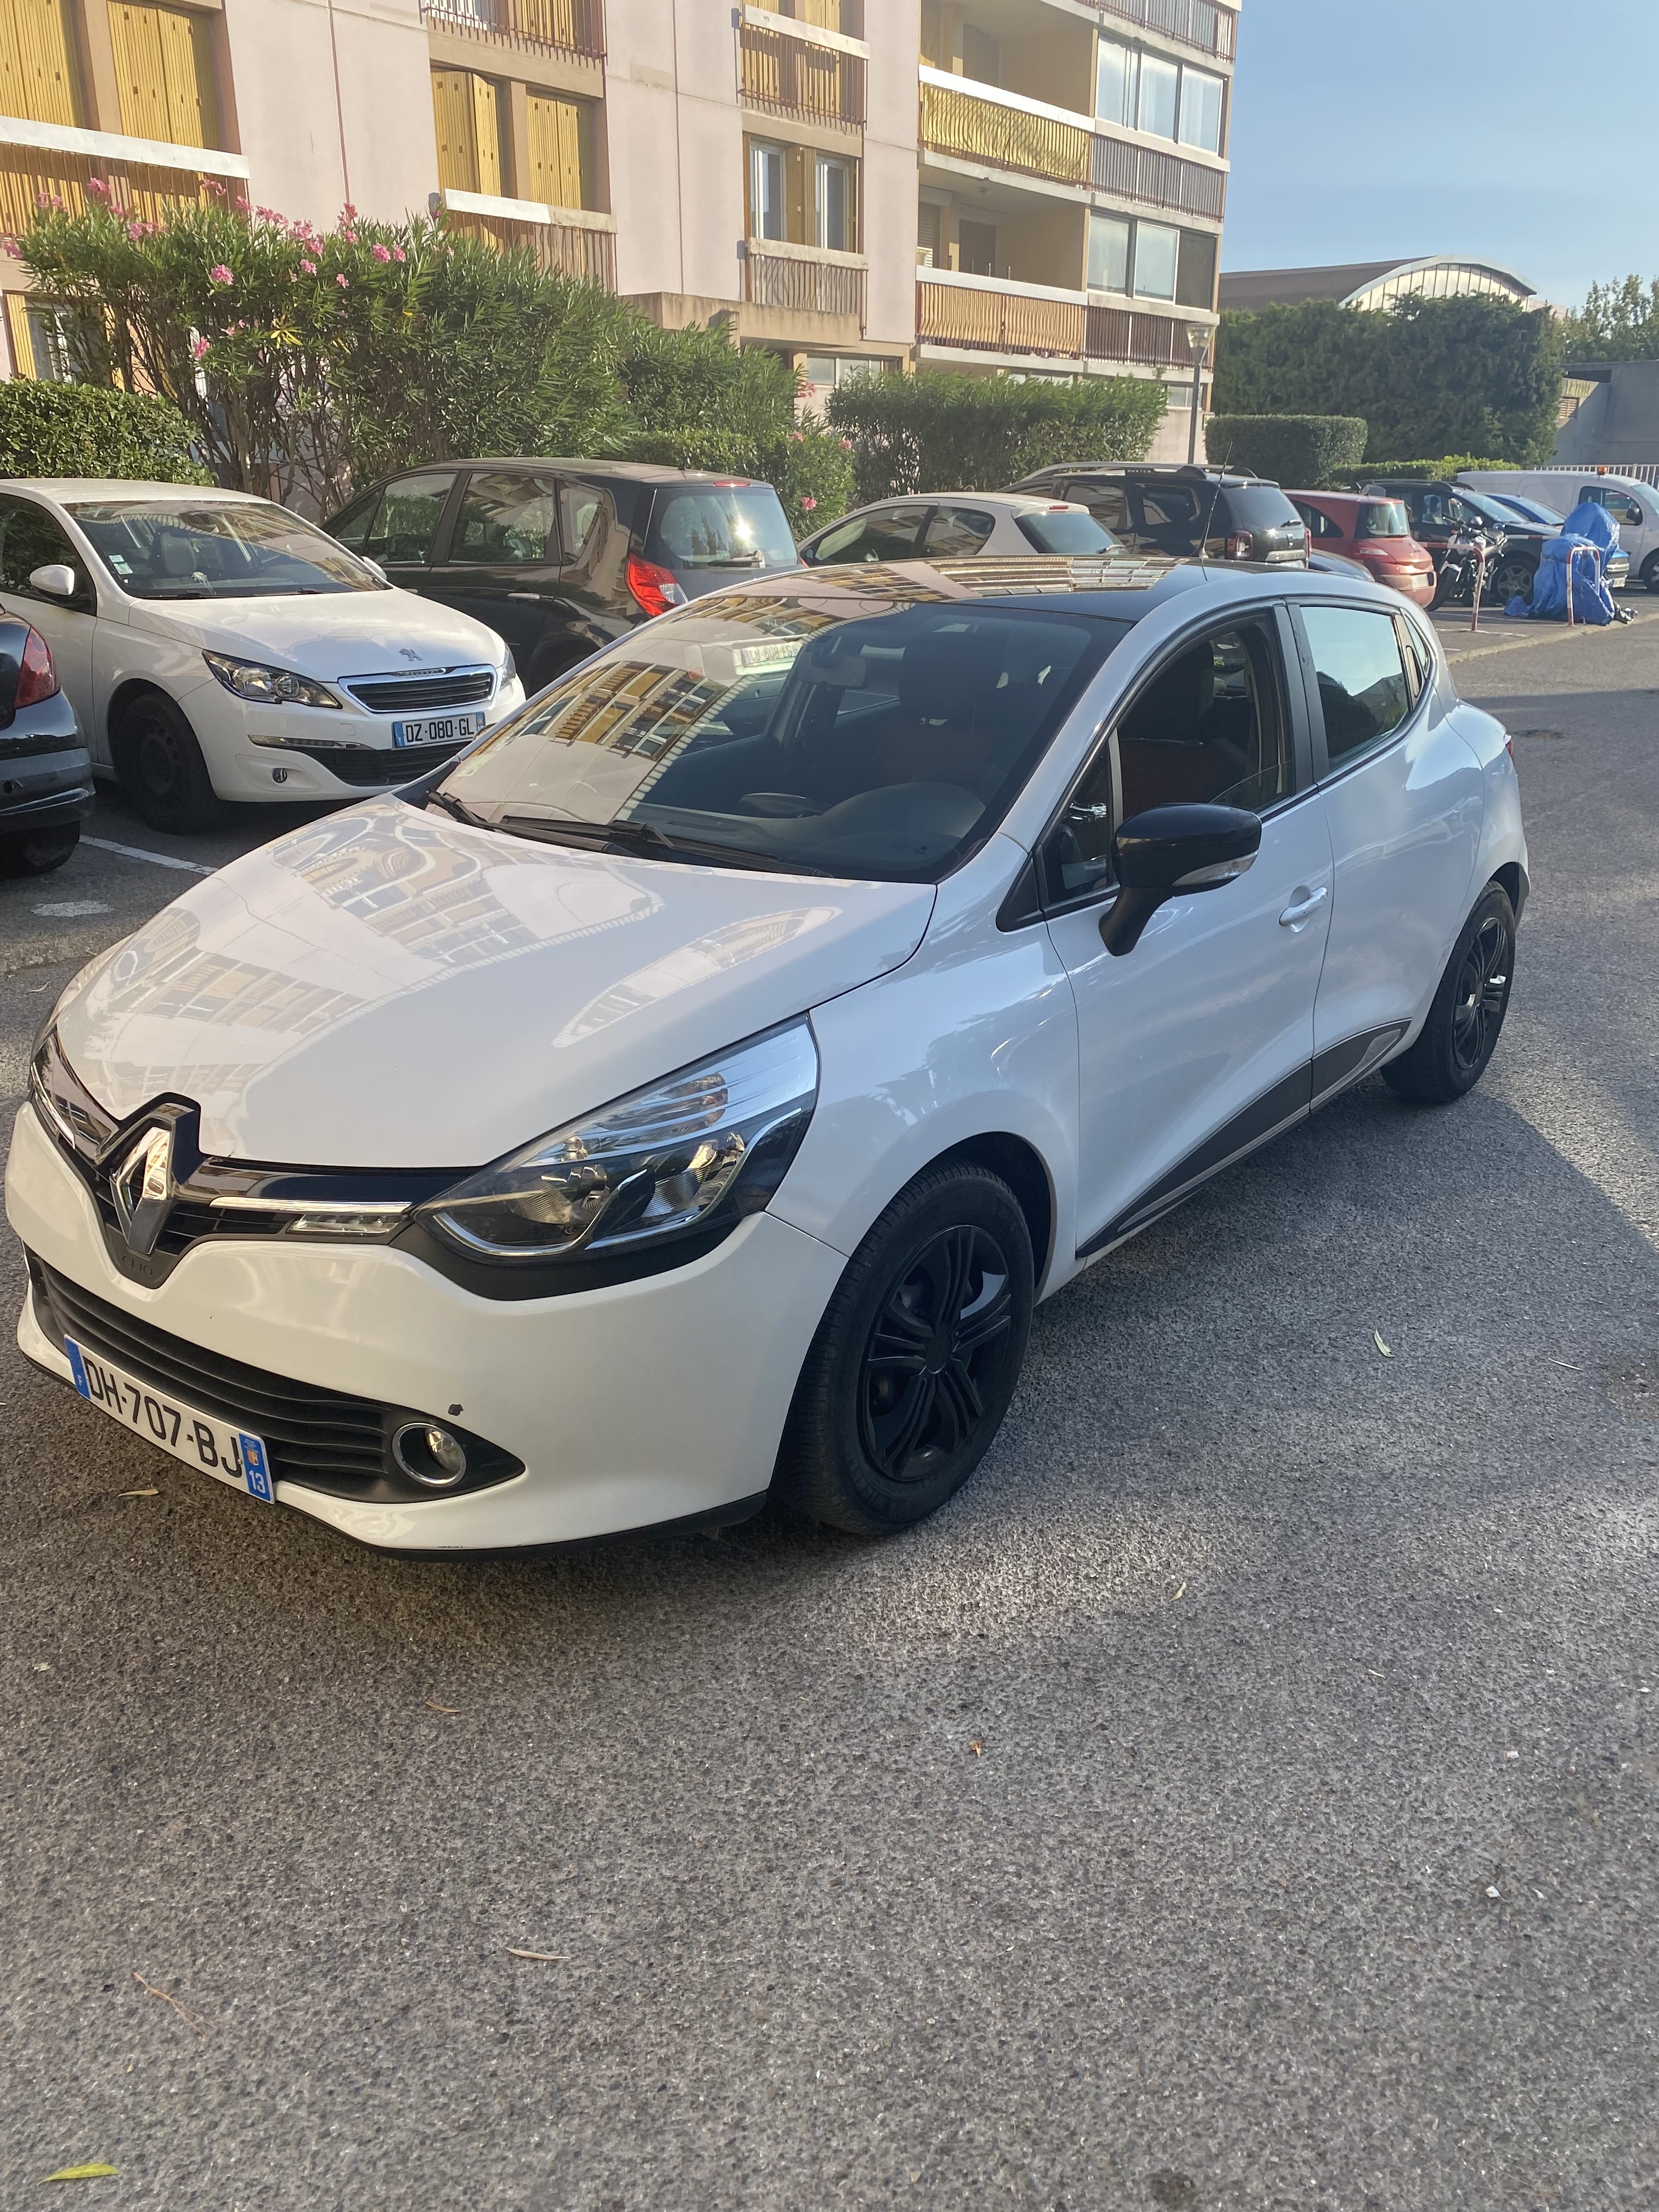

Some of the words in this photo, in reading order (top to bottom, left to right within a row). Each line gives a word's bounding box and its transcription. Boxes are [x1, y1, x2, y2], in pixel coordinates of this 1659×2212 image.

[405, 718, 475, 743] DZ-080-GL
[122, 1255, 153, 1277] CLIO
[77, 1374, 83, 1386] F
[83, 1355, 242, 1478] DH-707-BJ
[249, 1470, 266, 1494] 13
